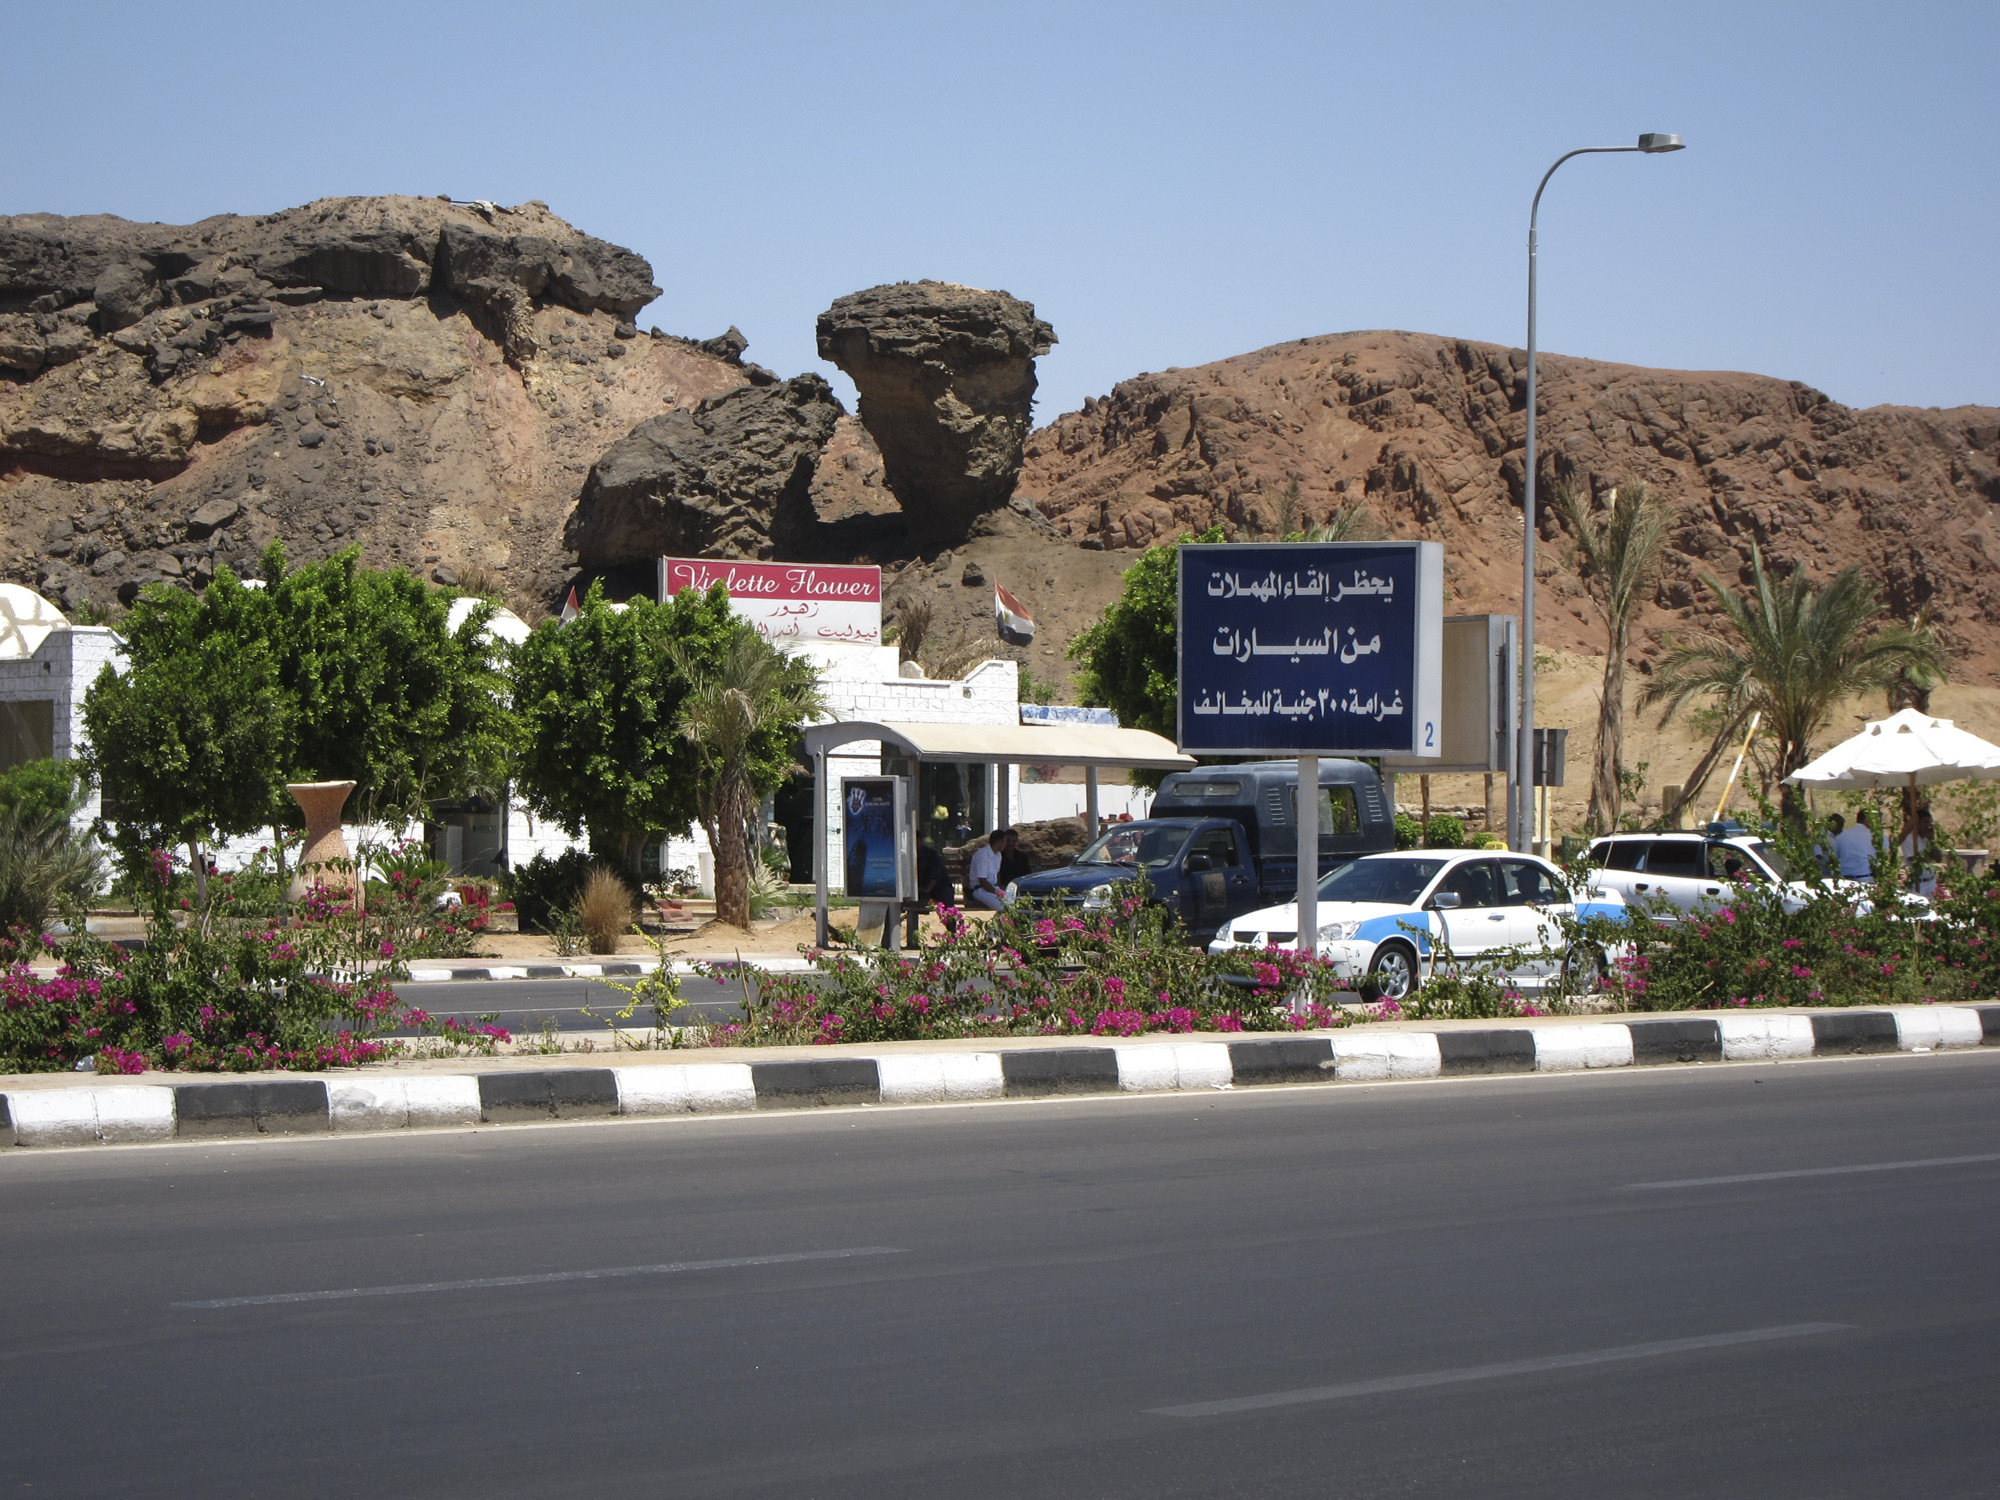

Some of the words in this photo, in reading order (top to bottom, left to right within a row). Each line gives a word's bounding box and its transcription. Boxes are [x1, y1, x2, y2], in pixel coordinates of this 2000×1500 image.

[786, 569, 875, 596] Flower
[1207, 570, 1282, 603] المهملات
[1284, 569, 1330, 603] إلقاء
[1331, 569, 1394, 603] يحظر
[766, 602, 819, 618] زهور
[817, 623, 879, 641] فيوليت
[1212, 626, 1338, 664] السيارات
[1340, 626, 1381, 664] من
[1193, 688, 1273, 717] للمخالف
[1348, 688, 1404, 722] غرامة
[1425, 721, 1434, 747] 2
